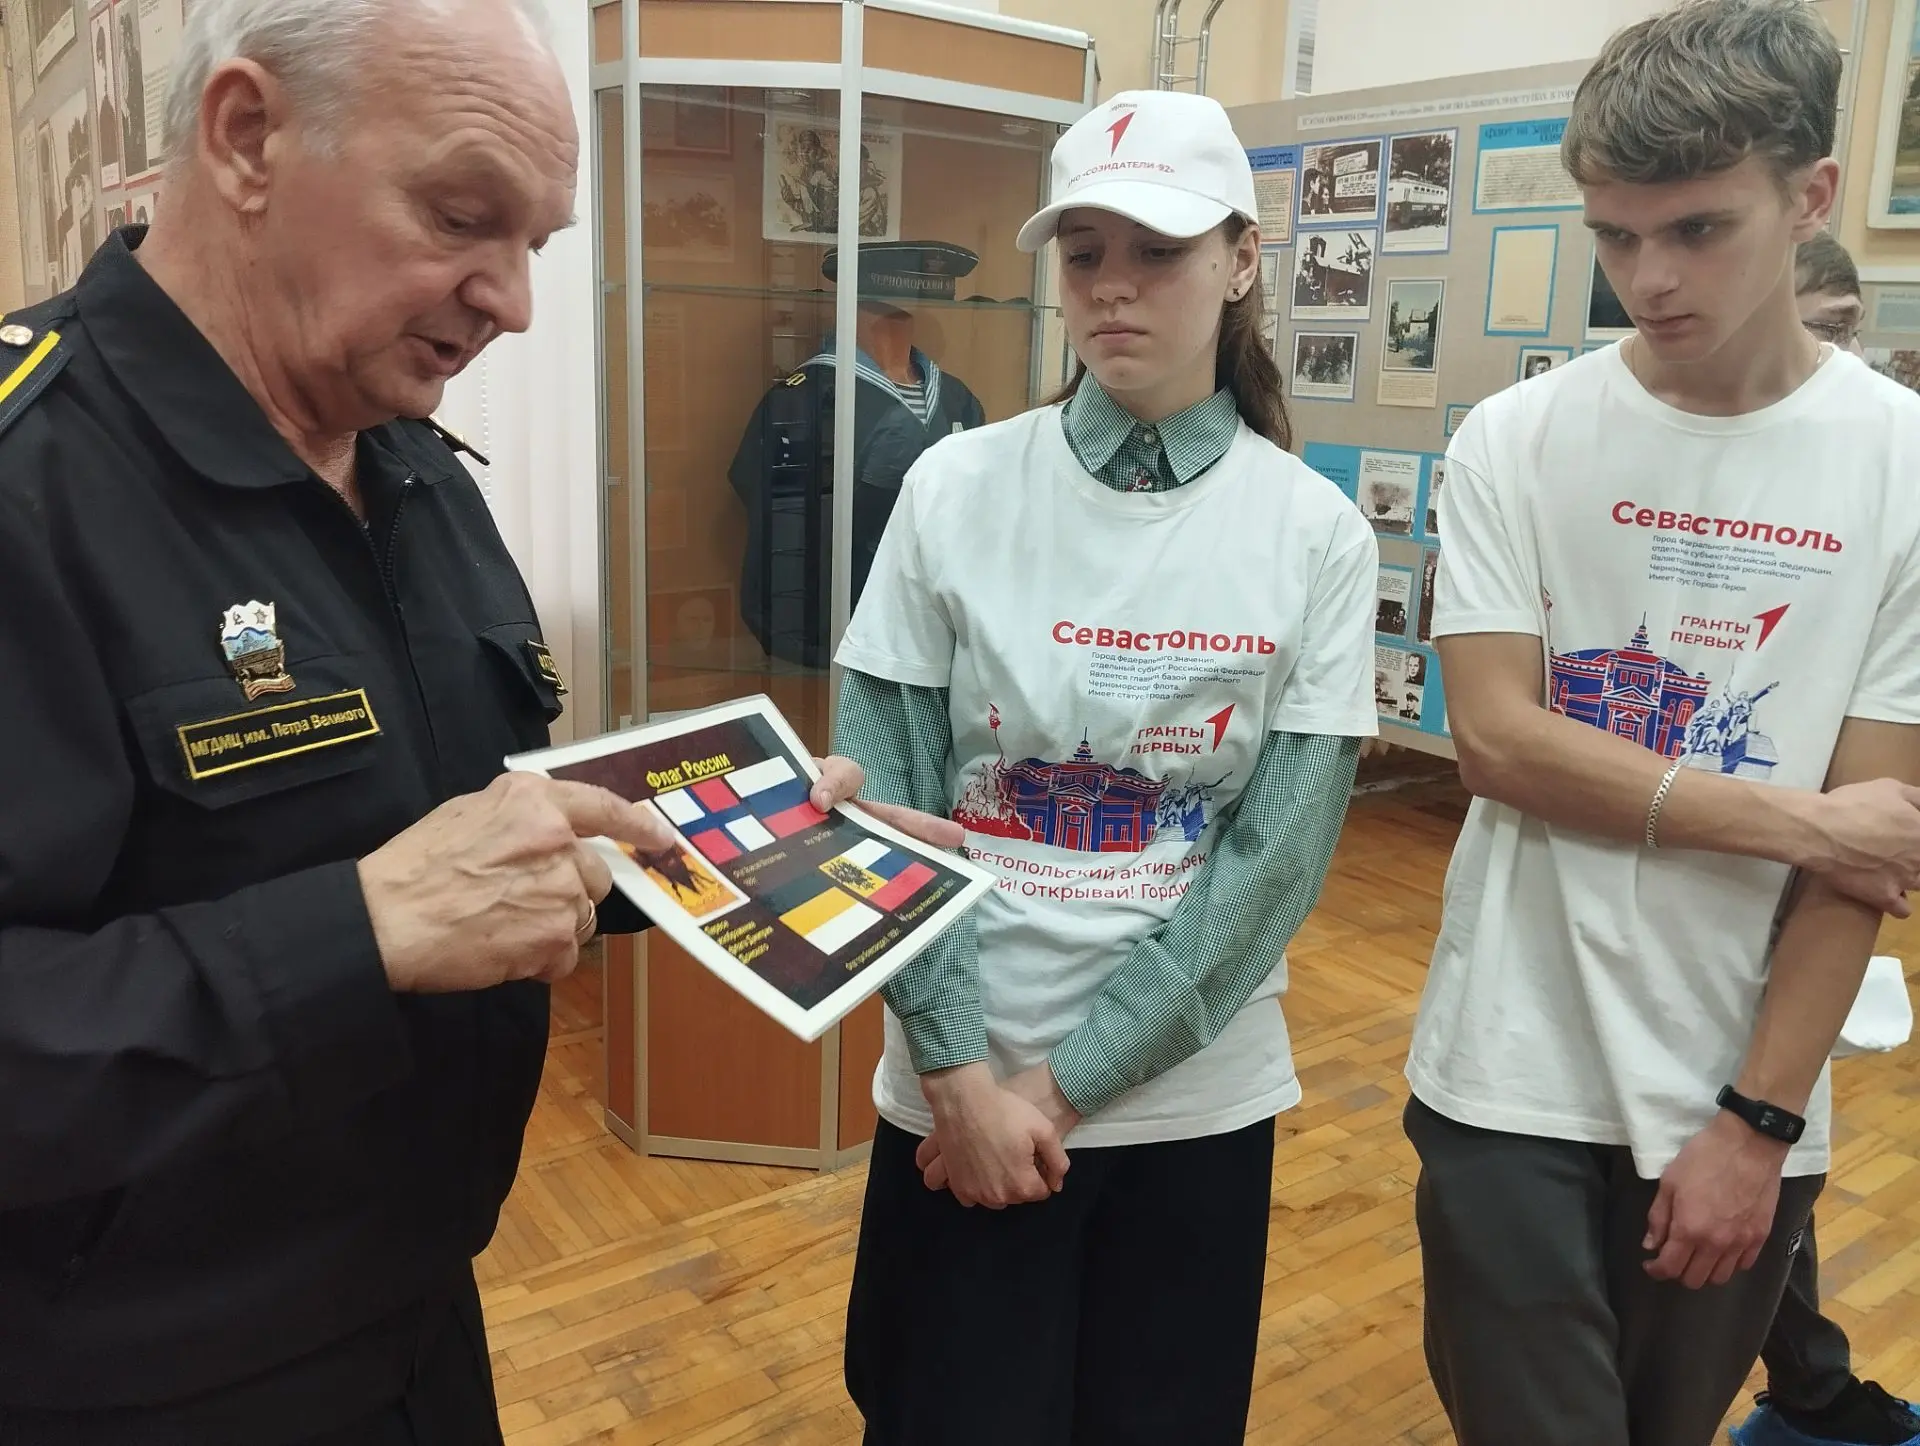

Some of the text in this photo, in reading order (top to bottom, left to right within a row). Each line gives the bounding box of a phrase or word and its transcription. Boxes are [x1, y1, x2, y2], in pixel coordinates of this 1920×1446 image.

[1612, 500, 1843, 553] Севастополь
[1680, 615, 1751, 634] ГРАНТЫ
[1052, 620, 1276, 655] Севастополь
[1670, 631, 1746, 651] ПЕРВЫХ
[1091, 652, 1116, 662] Город
[1089, 670, 1128, 680] Является
[1161, 673, 1187, 681] базой
[1189, 676, 1241, 684] российского
[1168, 664, 1219, 673] Российской
[1088, 688, 1115, 697] Имеет
[244, 728, 271, 745] им.
[272, 719, 310, 738] Петра
[310, 707, 366, 729] Великого
[1138, 727, 1205, 739] ГРАНТЫ
[1130, 742, 1202, 754] ПЕРВЫХ
[646, 753, 731, 788] Флаг России
[1021, 881, 1135, 902] Открывай!
[1141, 883, 1192, 901] Горди
